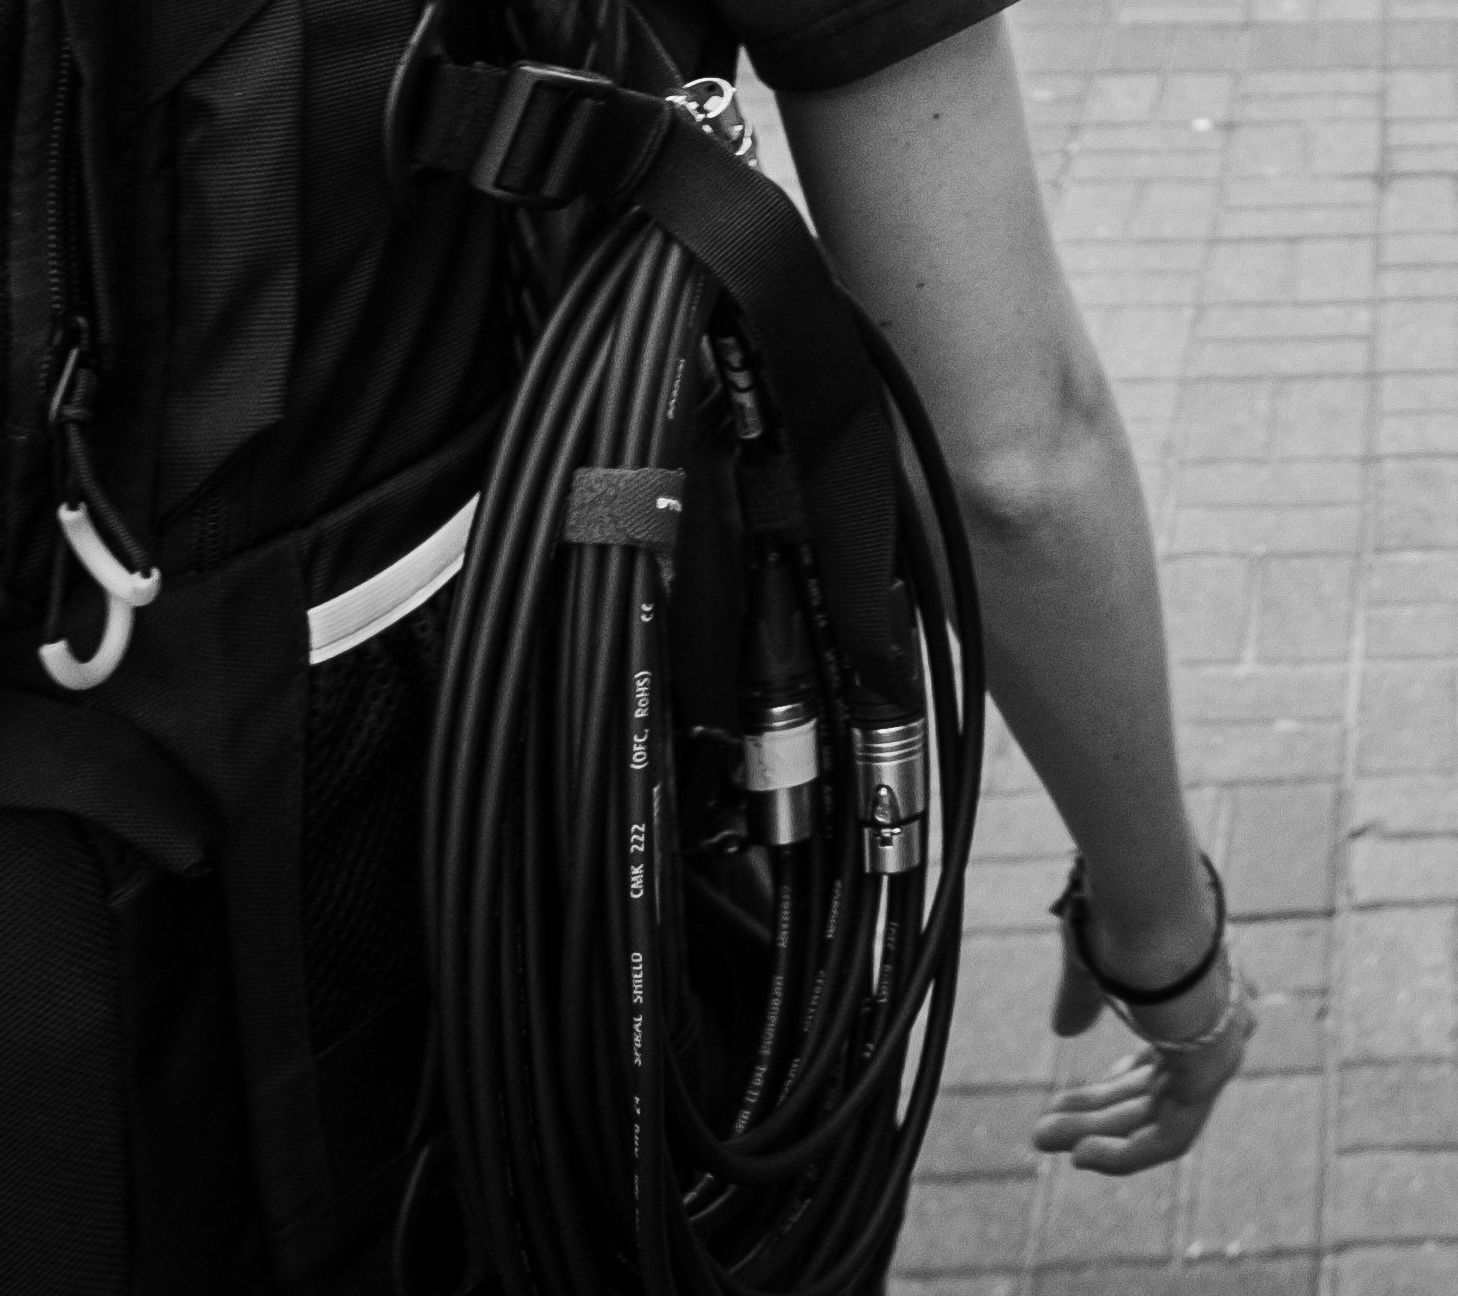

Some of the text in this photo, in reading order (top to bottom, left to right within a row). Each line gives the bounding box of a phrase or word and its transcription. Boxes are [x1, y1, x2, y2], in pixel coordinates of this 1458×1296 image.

[630, 823, 646, 853] 222
[629, 863, 645, 899] CMK
[630, 952, 644, 1005] SHIELD
